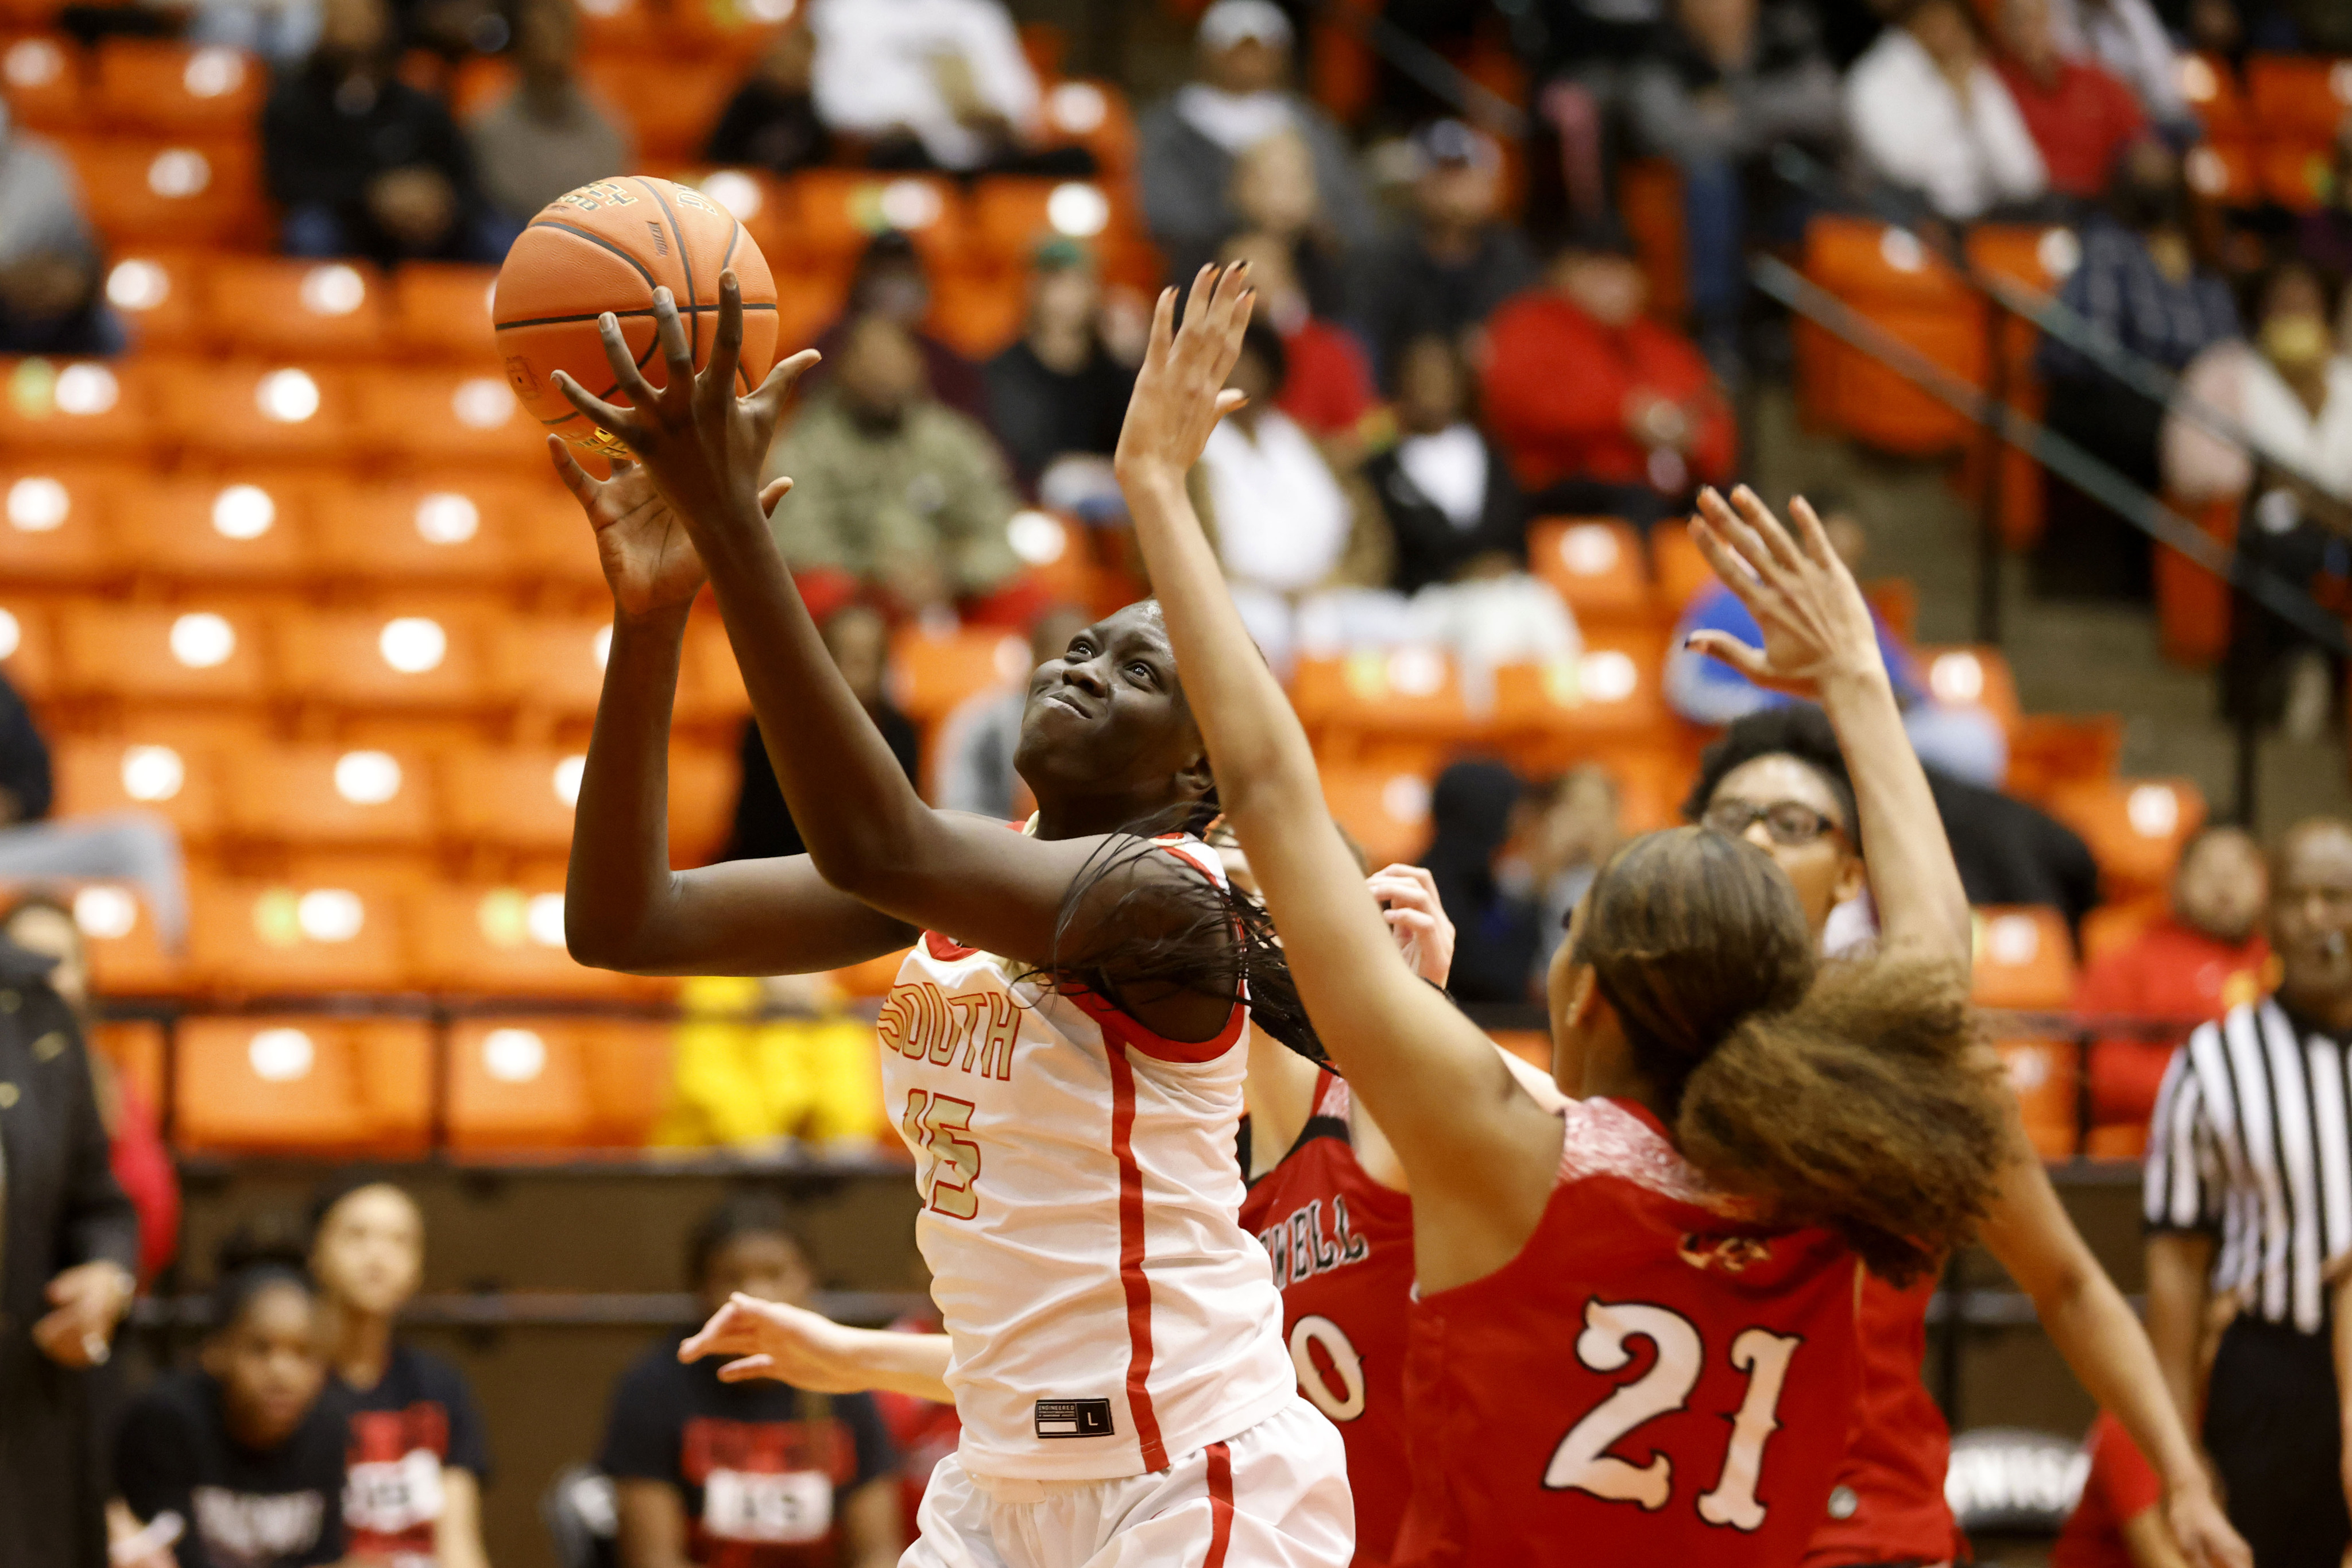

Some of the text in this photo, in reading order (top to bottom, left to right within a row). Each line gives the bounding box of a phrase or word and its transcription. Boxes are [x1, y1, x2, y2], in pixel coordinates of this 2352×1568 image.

[877, 981, 1022, 1082] SOUTH
[902, 1088, 981, 1221] 15
[1088, 1412, 1098, 1426] L
[1540, 1295, 1806, 1534] 21
